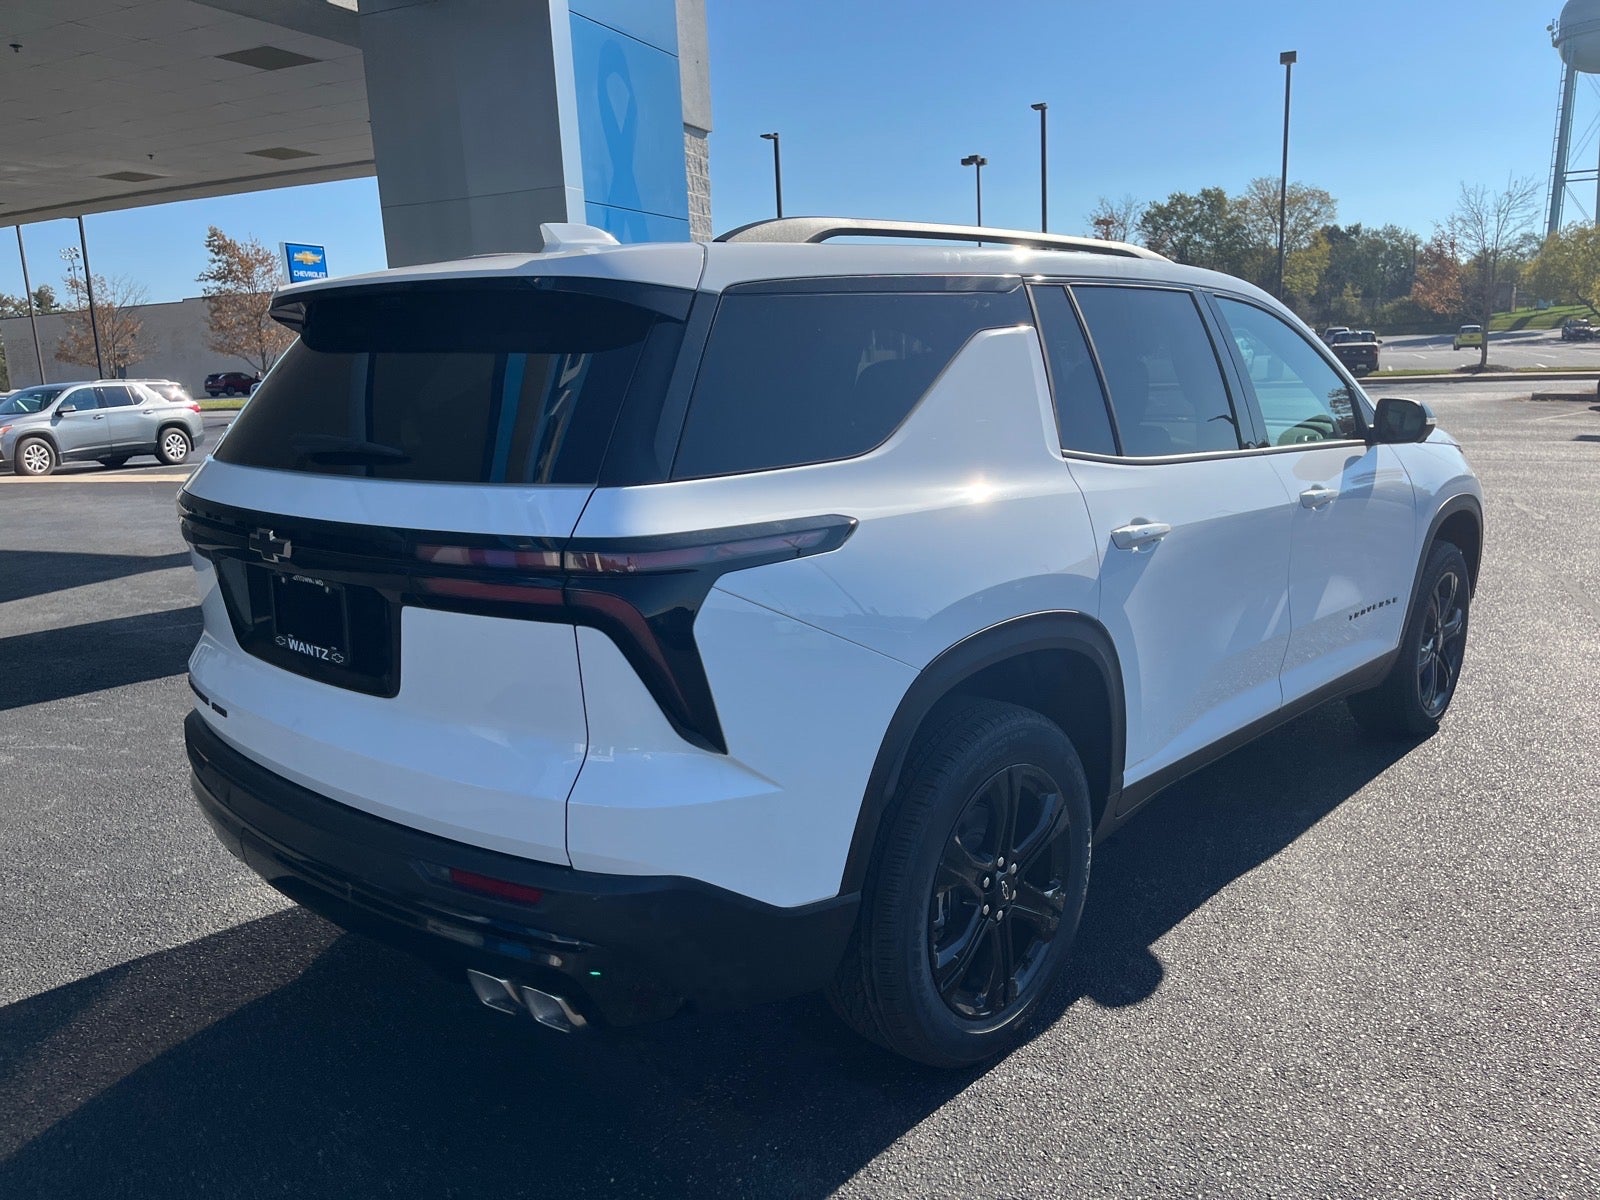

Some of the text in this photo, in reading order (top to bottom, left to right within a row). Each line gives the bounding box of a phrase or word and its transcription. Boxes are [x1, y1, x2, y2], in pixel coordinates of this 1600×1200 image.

[293, 270, 326, 278] CHEVROLET
[1348, 597, 1398, 621] TRAVERSE
[287, 637, 330, 661] WANTZ
